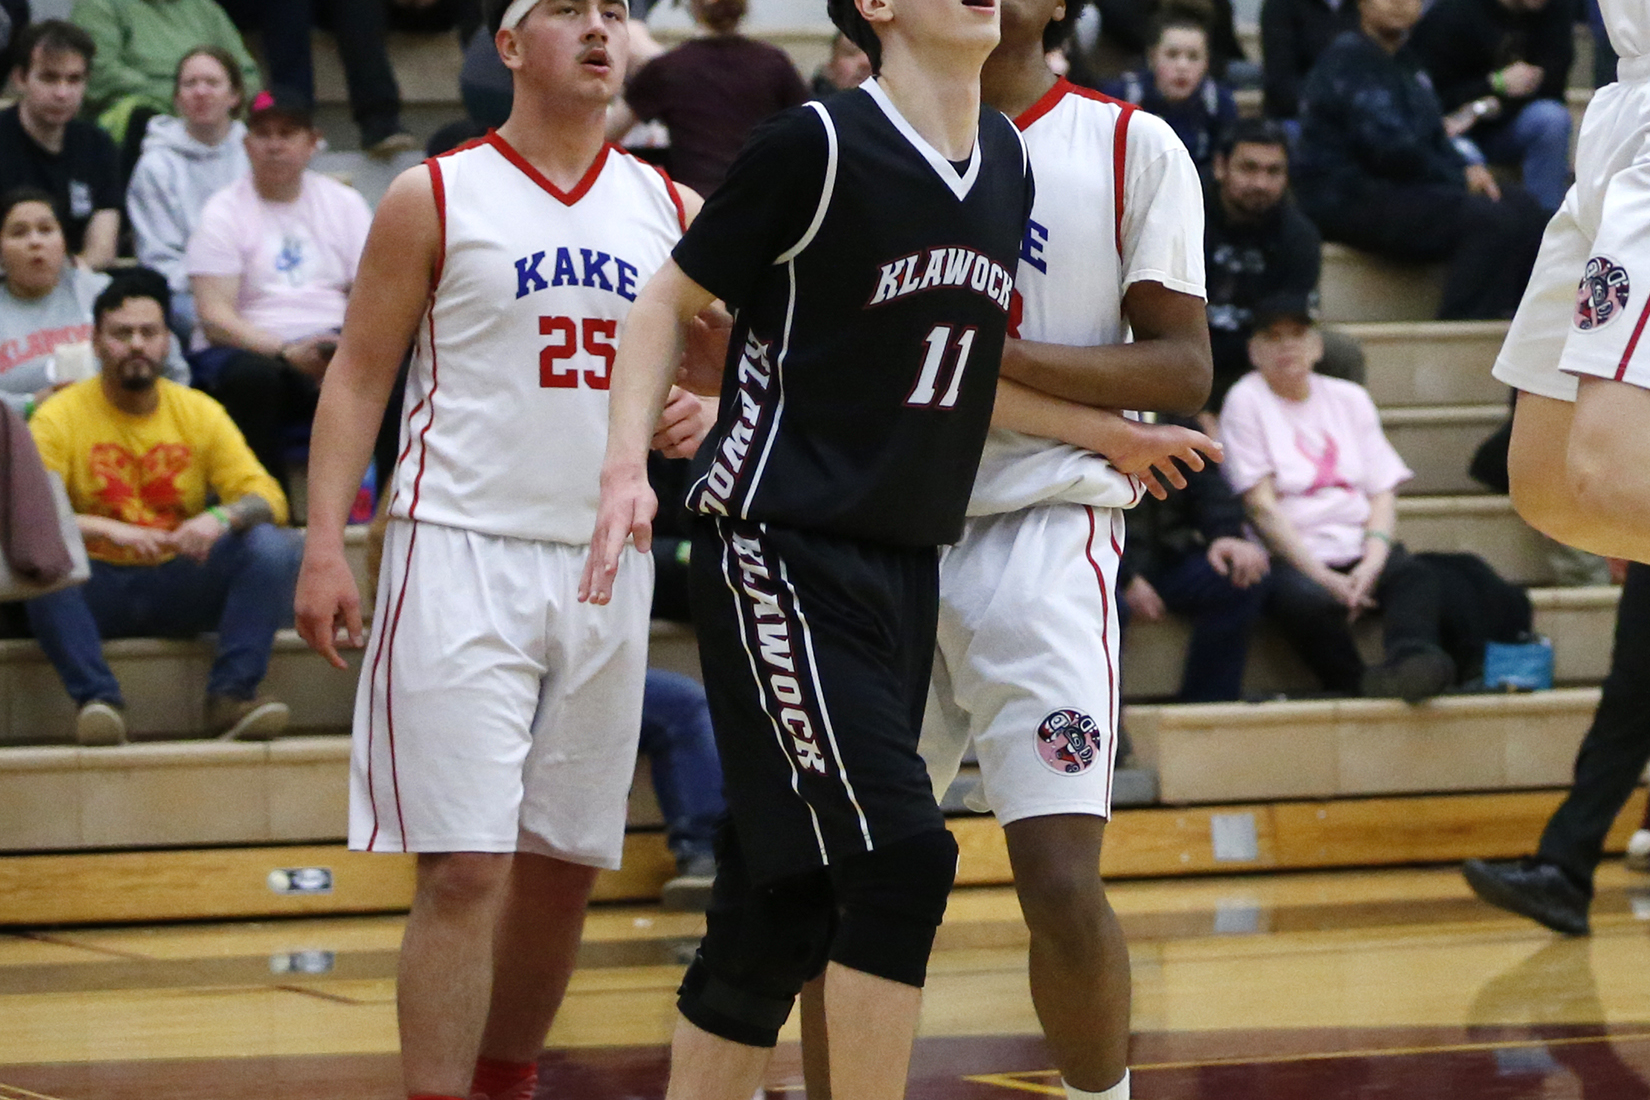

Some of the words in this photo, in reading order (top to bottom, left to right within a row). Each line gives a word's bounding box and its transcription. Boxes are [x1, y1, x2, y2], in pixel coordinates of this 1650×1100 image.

[513, 247, 638, 301] KAKE
[868, 246, 1014, 312] KLAWOCK
[538, 315, 618, 390] 25
[903, 323, 979, 410] 11
[731, 520, 829, 778] KLAWOCK
